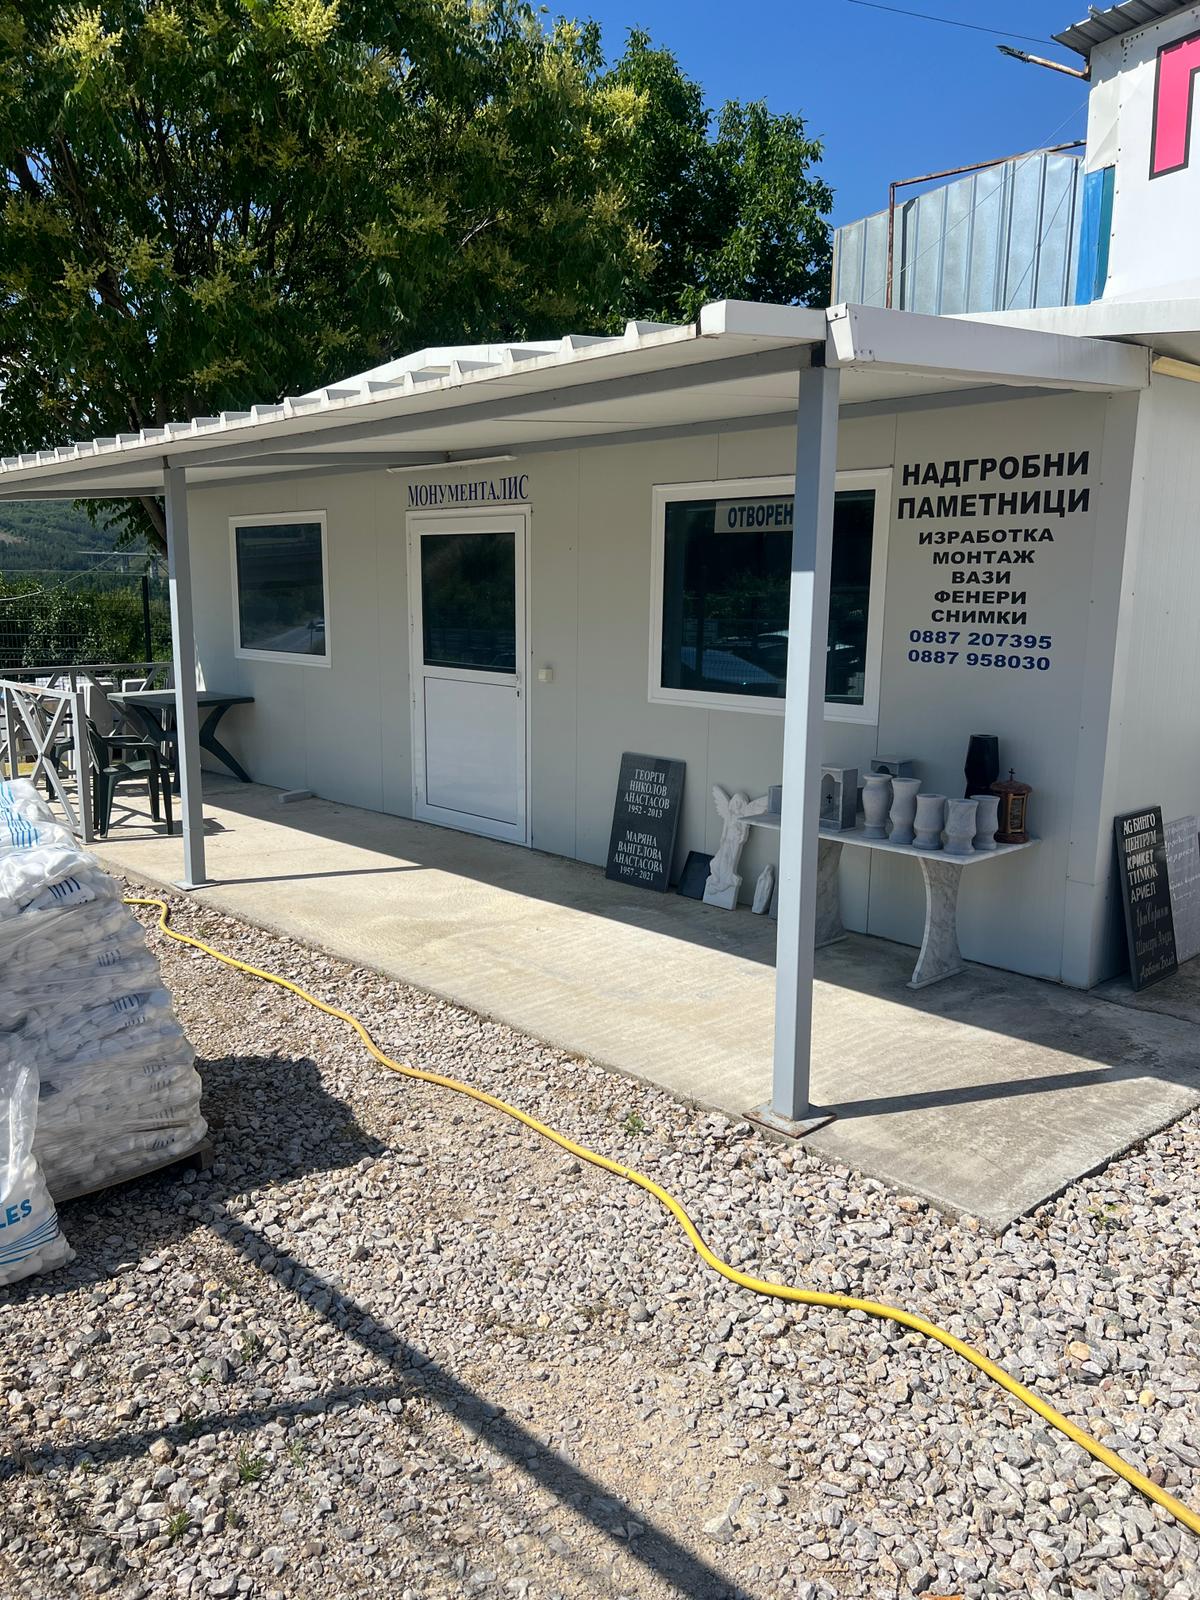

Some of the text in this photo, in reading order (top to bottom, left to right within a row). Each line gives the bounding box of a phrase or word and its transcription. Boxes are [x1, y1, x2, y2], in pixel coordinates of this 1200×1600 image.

[902, 451, 1090, 487] НАДГРОБНИ
[408, 474, 529, 507] МОНУМЕНТАЛИС
[897, 488, 1090, 519] ПАМЕТНИЦИ
[918, 528, 1054, 545] ИЗРАБОТКА
[932, 550, 1036, 565] МОНТАЖ
[951, 571, 1011, 584] ВАЗИ
[934, 590, 1027, 605] ФЕНЕРИ
[931, 609, 1027, 625] СНИМКИ
[909, 630, 1052, 649] 0887 207395
[908, 649, 1050, 671] 0887 958030
[635, 769, 665, 784] ГЕОРГИ
[630, 780, 668, 797] НИКОЛОВ
[624, 792, 670, 810] АНАСТАСОВ
[628, 804, 642, 815] 1952
[625, 830, 657, 847] МАРЯНА
[1125, 830, 1157, 854] ЦЕНТРУМ
[617, 841, 662, 861] ВАНГЕЛОВА
[613, 853, 663, 873] АНАСТАСОВА
[619, 865, 634, 876] 1957
[1131, 882, 1157, 904] АРИЕЛ
